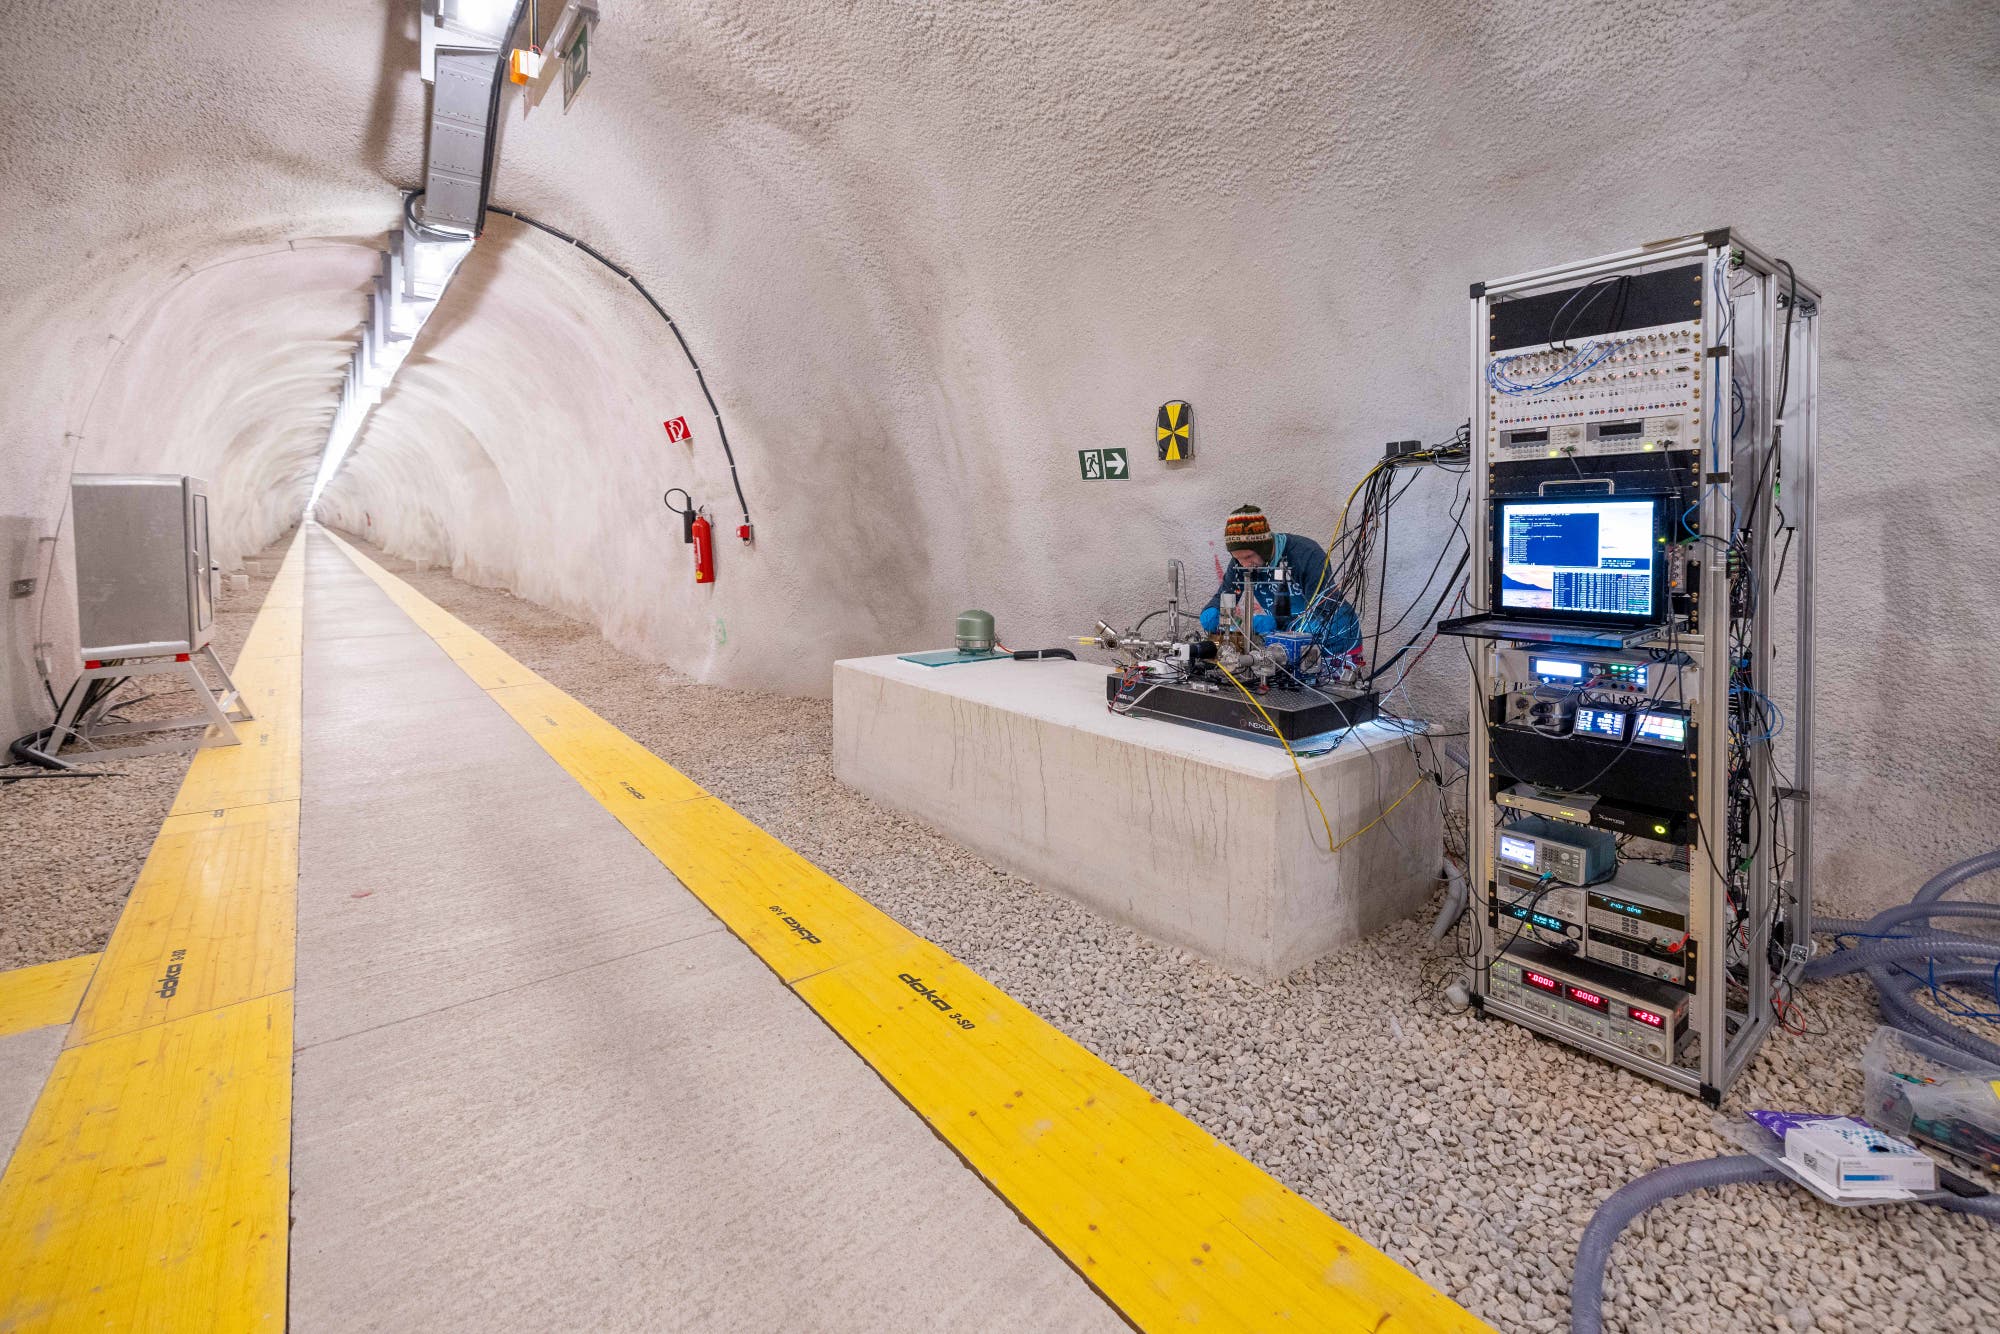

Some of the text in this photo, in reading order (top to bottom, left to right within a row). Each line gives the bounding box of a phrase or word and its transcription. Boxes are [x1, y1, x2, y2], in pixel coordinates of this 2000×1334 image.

[782, 916, 822, 944] doka
[155, 963, 183, 999] doka
[898, 973, 953, 1012] doka
